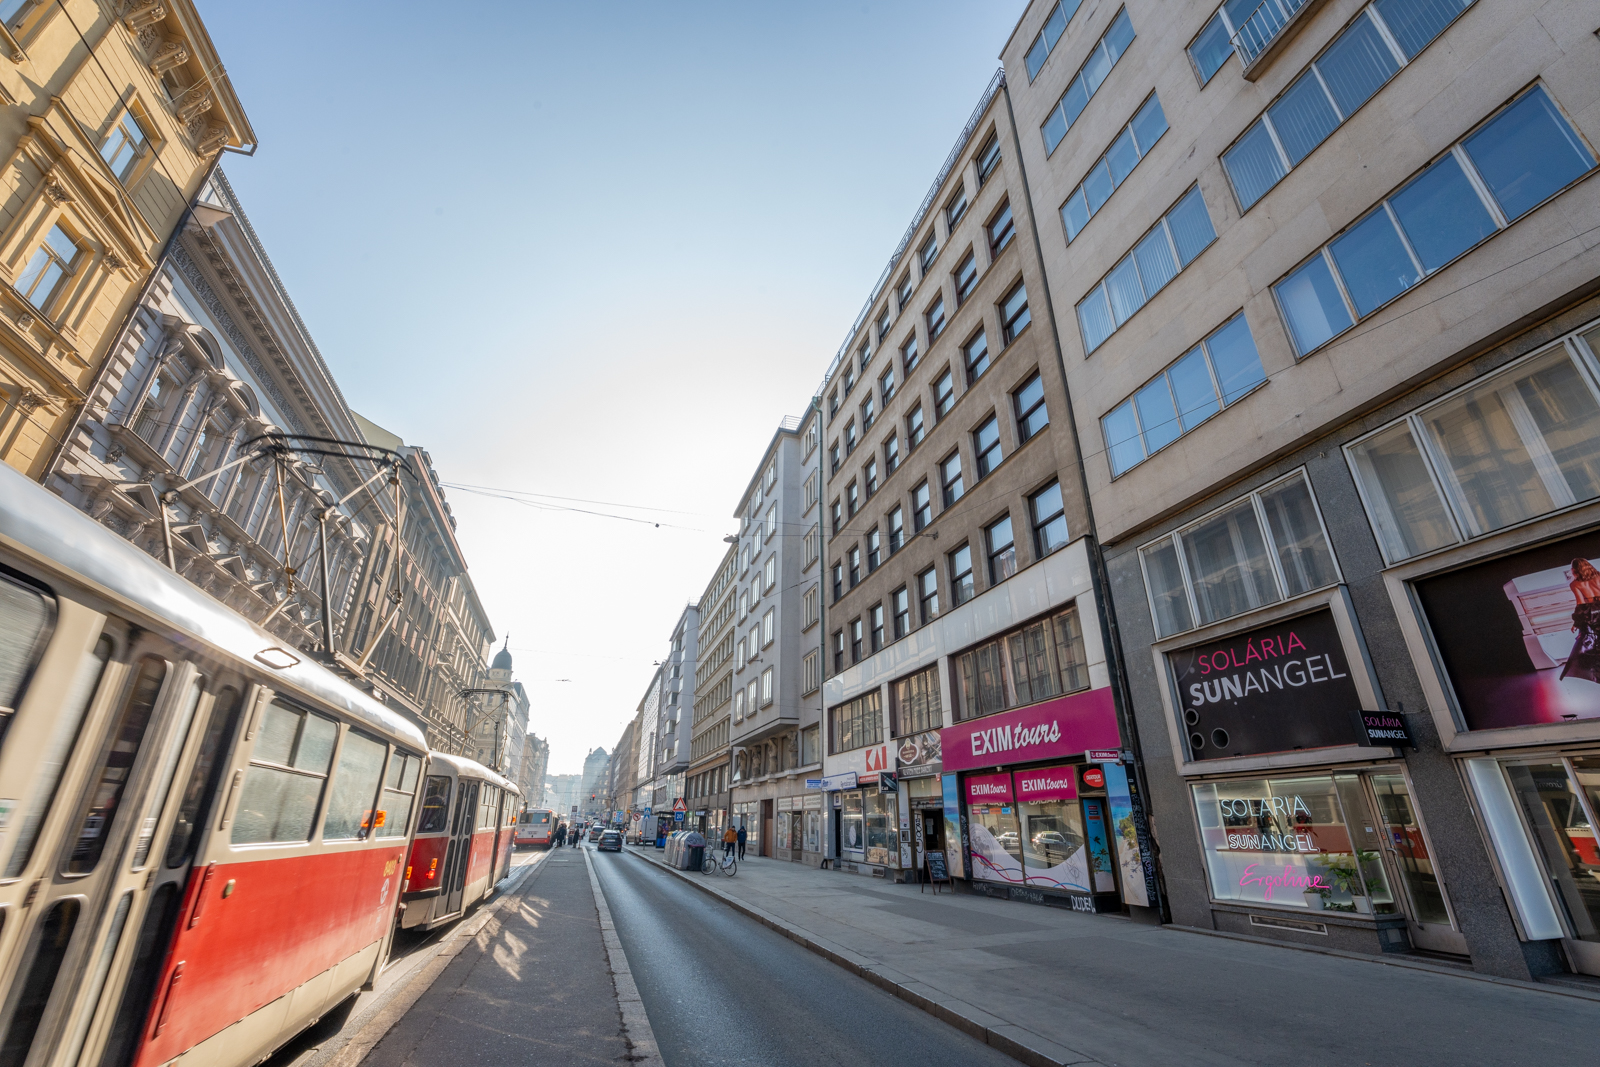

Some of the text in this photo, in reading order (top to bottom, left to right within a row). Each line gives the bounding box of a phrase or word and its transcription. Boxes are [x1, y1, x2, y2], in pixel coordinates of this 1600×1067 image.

[1198, 631, 1306, 674] SOLÁRIA
[1189, 653, 1346, 706] SUNANGEL
[1364, 715, 1402, 727] SOLÁRIA
[1368, 729, 1408, 739] SUNANGEL
[1228, 833, 1320, 852] SUNANGEL
[1239, 863, 1331, 900] Ergoline
